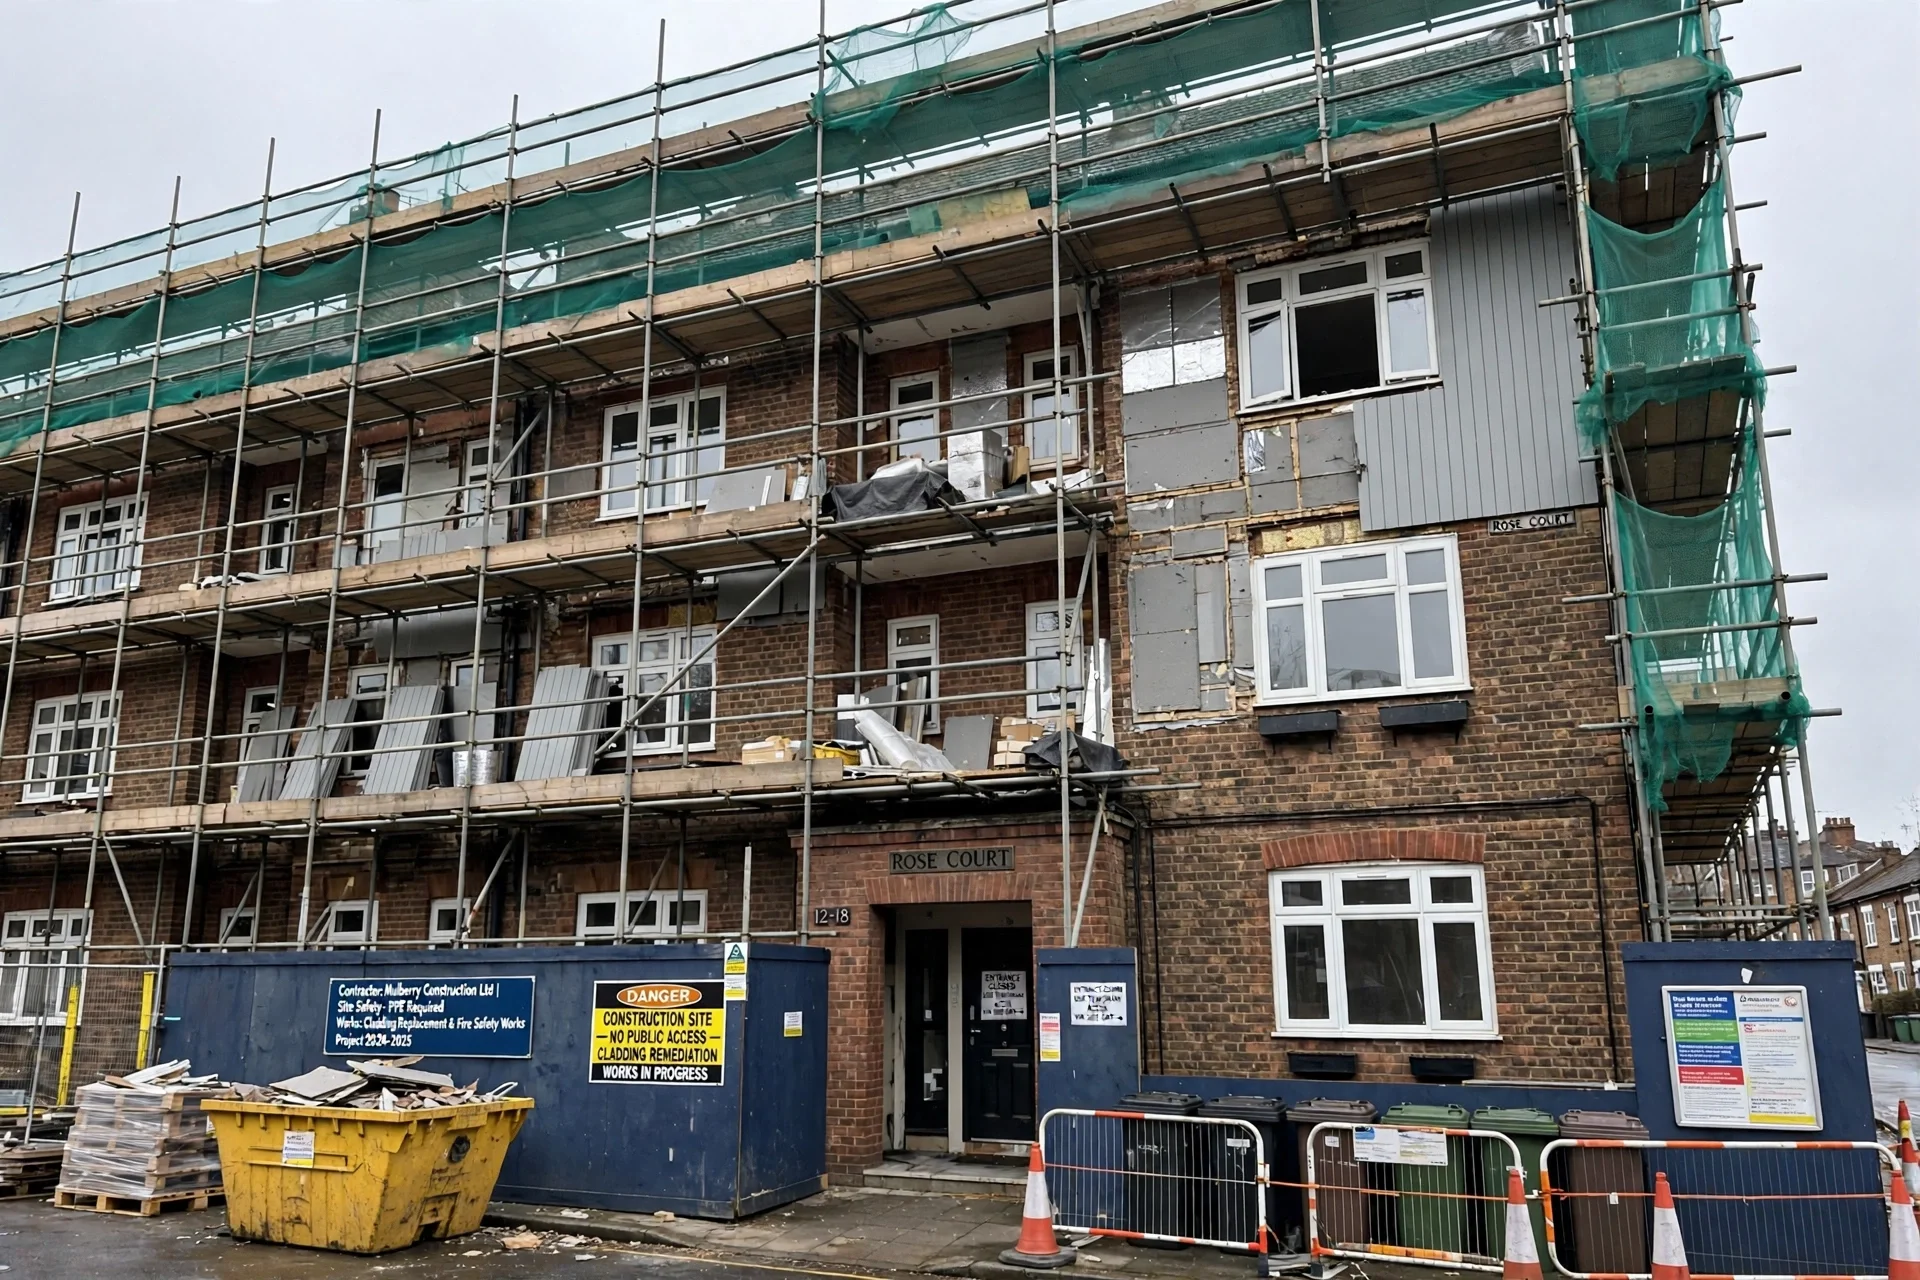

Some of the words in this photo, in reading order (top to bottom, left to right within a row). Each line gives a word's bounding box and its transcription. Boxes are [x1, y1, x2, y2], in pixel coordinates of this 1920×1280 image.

[1493, 519, 1523, 531] ROSE
[1529, 513, 1570, 527] COURT
[892, 852, 938, 870] ROSE
[946, 849, 1010, 868] COURT
[814, 908, 850, 924] 12-18
[338, 984, 383, 997] Contractor:
[384, 982, 421, 1000] Mulberry
[423, 983, 477, 997] Construction
[479, 983, 494, 997] Ltd
[626, 989, 690, 1003] DANGER
[337, 1000, 354, 1013] Site
[388, 1000, 406, 1013] PPE
[406, 999, 445, 1017] Required
[473, 1016, 500, 1033] Safety
[500, 1016, 526, 1030] Works
[603, 1011, 685, 1027] CONSTRUCTION
[688, 1011, 713, 1027] SITE
[335, 1033, 363, 1049] Project
[609, 1030, 624, 1044] NO
[627, 1030, 664, 1044] PUBLIC
[667, 1030, 707, 1044] ACCESS
[597, 1047, 647, 1061] CLADDING
[649, 1047, 718, 1062] REMEDIATION
[602, 1065, 639, 1079] WORKS
[640, 1065, 651, 1080] IN
[653, 1066, 709, 1081] PROGRESS
